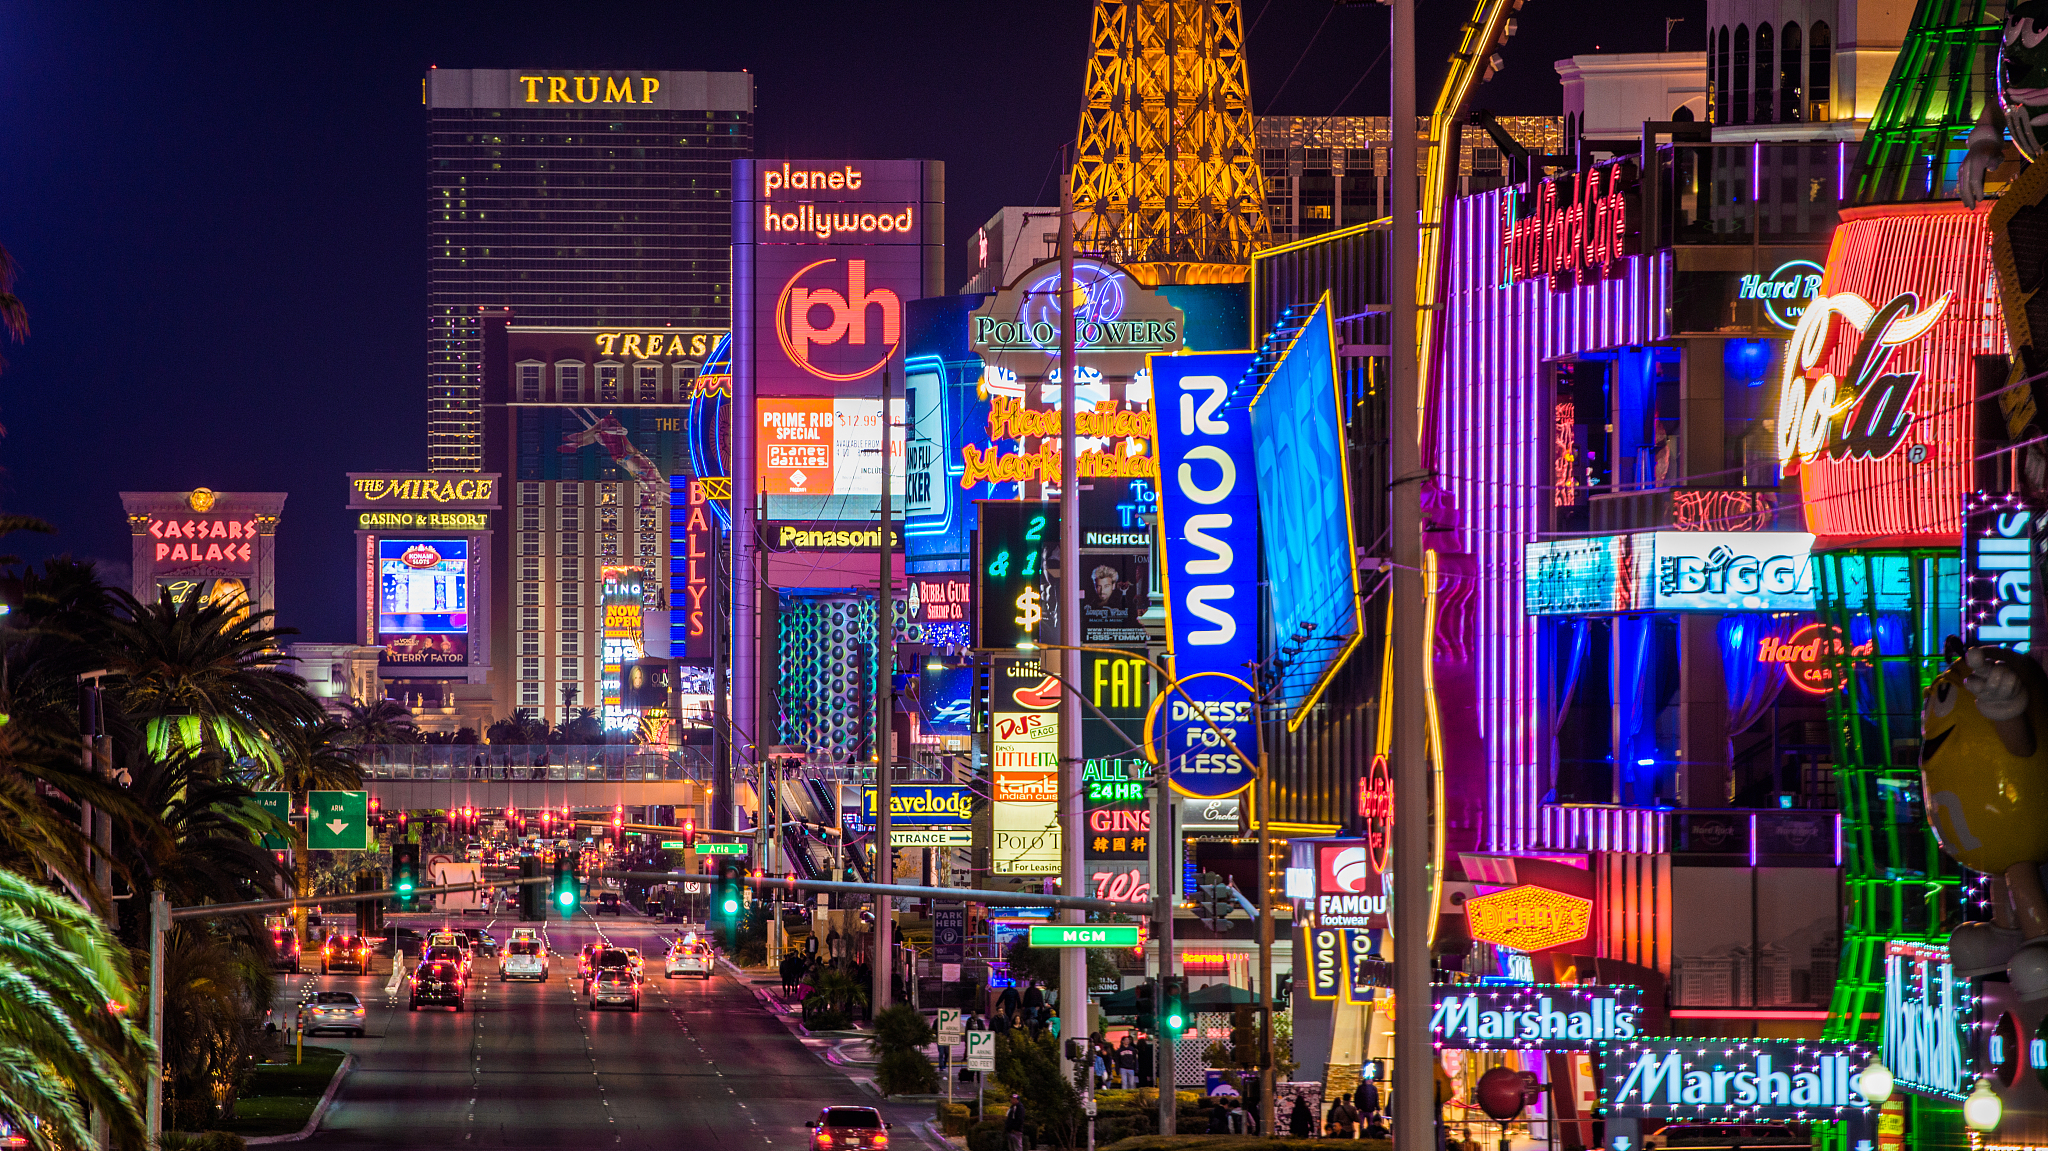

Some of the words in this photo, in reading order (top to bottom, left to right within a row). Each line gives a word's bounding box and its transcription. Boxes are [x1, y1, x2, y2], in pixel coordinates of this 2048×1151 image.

[520, 76, 660, 104] TRUMP
[763, 163, 862, 197] planet
[764, 205, 913, 238] hollywood
[1499, 182, 1542, 289] Hard
[1542, 172, 1584, 293] Rock
[1583, 162, 1626, 281] Cafe
[1739, 274, 1801, 299] Hard
[791, 259, 901, 363] ph
[975, 316, 1054, 344] POLO
[1074, 316, 1178, 344] TOWERS
[655, 417, 680, 431] THE
[763, 412, 806, 428] PRIME
[809, 411, 834, 428] RIB
[839, 415, 877, 427] $12.99
[776, 427, 821, 440] SPECIAL
[919, 445, 931, 467] FLU
[353, 479, 385, 492] THE
[364, 479, 493, 503] MIRAGE
[906, 472, 931, 503] CKER
[360, 513, 413, 525] CASINO
[415, 513, 427, 525] &
[430, 513, 488, 525] RESORT
[1176, 375, 1237, 647] ROSS
[149, 519, 257, 540] CAESARS
[1025, 515, 1046, 541] 2
[156, 542, 251, 562] PALACE
[604, 583, 641, 595] LINQ
[920, 580, 946, 603] BUBBA
[946, 579, 971, 603] GUM
[606, 604, 641, 617] NOW
[926, 603, 950, 620] SHRIMP
[604, 615, 643, 628] OPEN
[395, 653, 429, 663] TERRY
[430, 653, 464, 663] FATOR
[1758, 636, 1822, 662] Hard
[1093, 658, 1147, 708] FAT
[1171, 701, 1252, 723] DRESS
[1030, 725, 1055, 739] TACO
[1185, 727, 1238, 748] FOR
[1081, 758, 1128, 781] ALL
[1180, 753, 1243, 774] LESS
[263, 799, 277, 807] And
[864, 789, 973, 819] Tavelodg
[999, 792, 1033, 800] indian
[330, 804, 344, 812] ARIA
[890, 833, 947, 844] NTRANCE
[996, 832, 1044, 850] POLO
[708, 845, 729, 853] Aria
[1014, 863, 1028, 871] For
[935, 911, 963, 919] PARK
[1320, 895, 1387, 915] FAMOU
[935, 919, 963, 927] HERE
[1320, 914, 1369, 926] footwear
[1479, 903, 1582, 934] Denny's
[1062, 930, 1107, 942] MGM
[1429, 996, 1637, 1040] Marshalls
